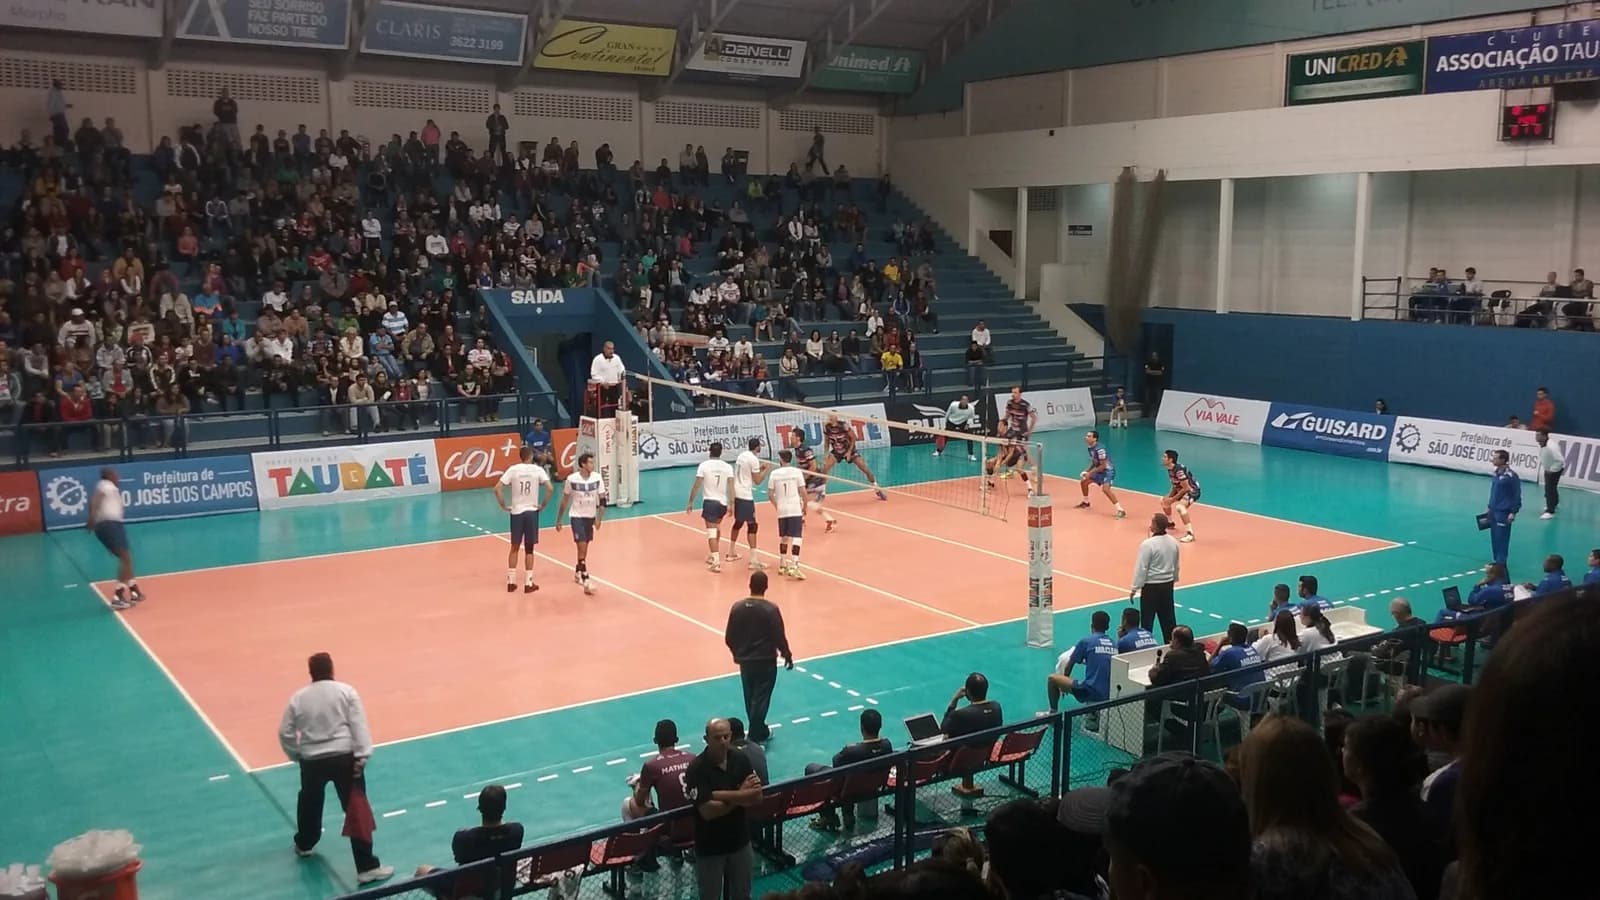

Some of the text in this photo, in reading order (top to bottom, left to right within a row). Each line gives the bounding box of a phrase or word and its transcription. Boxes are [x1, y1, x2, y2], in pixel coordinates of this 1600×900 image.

[249, 10, 328, 26] FAZ PARTE DO
[248, 23, 319, 39] NOSSO TIME
[375, 18, 441, 40] CLARIS
[450, 36, 475, 48] 3622
[1305, 52, 1383, 77] UNICRED
[1436, 42, 1558, 72] ASSOCIAÇÃO
[511, 288, 565, 304] SAÍDA
[907, 414, 982, 433] PUE
[1196, 409, 1240, 426] VIA VALE
[694, 424, 739, 437] Prefeitura de
[1302, 416, 1388, 440] GUISARD
[668, 439, 689, 455] SÃO
[732, 434, 766, 449] CAMS
[1461, 431, 1512, 448] Prefeitura de
[1428, 439, 1449, 456] SÃO
[1449, 443, 1476, 460] JOSÉ
[1510, 451, 1539, 469] MPOS
[143, 468, 214, 485] Prefeitura de
[268, 452, 429, 498] TAUBATÉ
[714, 475, 721, 488] 7
[134, 484, 171, 506] JOSÉ
[172, 485, 200, 503] DOS
[202, 480, 253, 501] CAMPOS
[519, 480, 531, 496] 18
